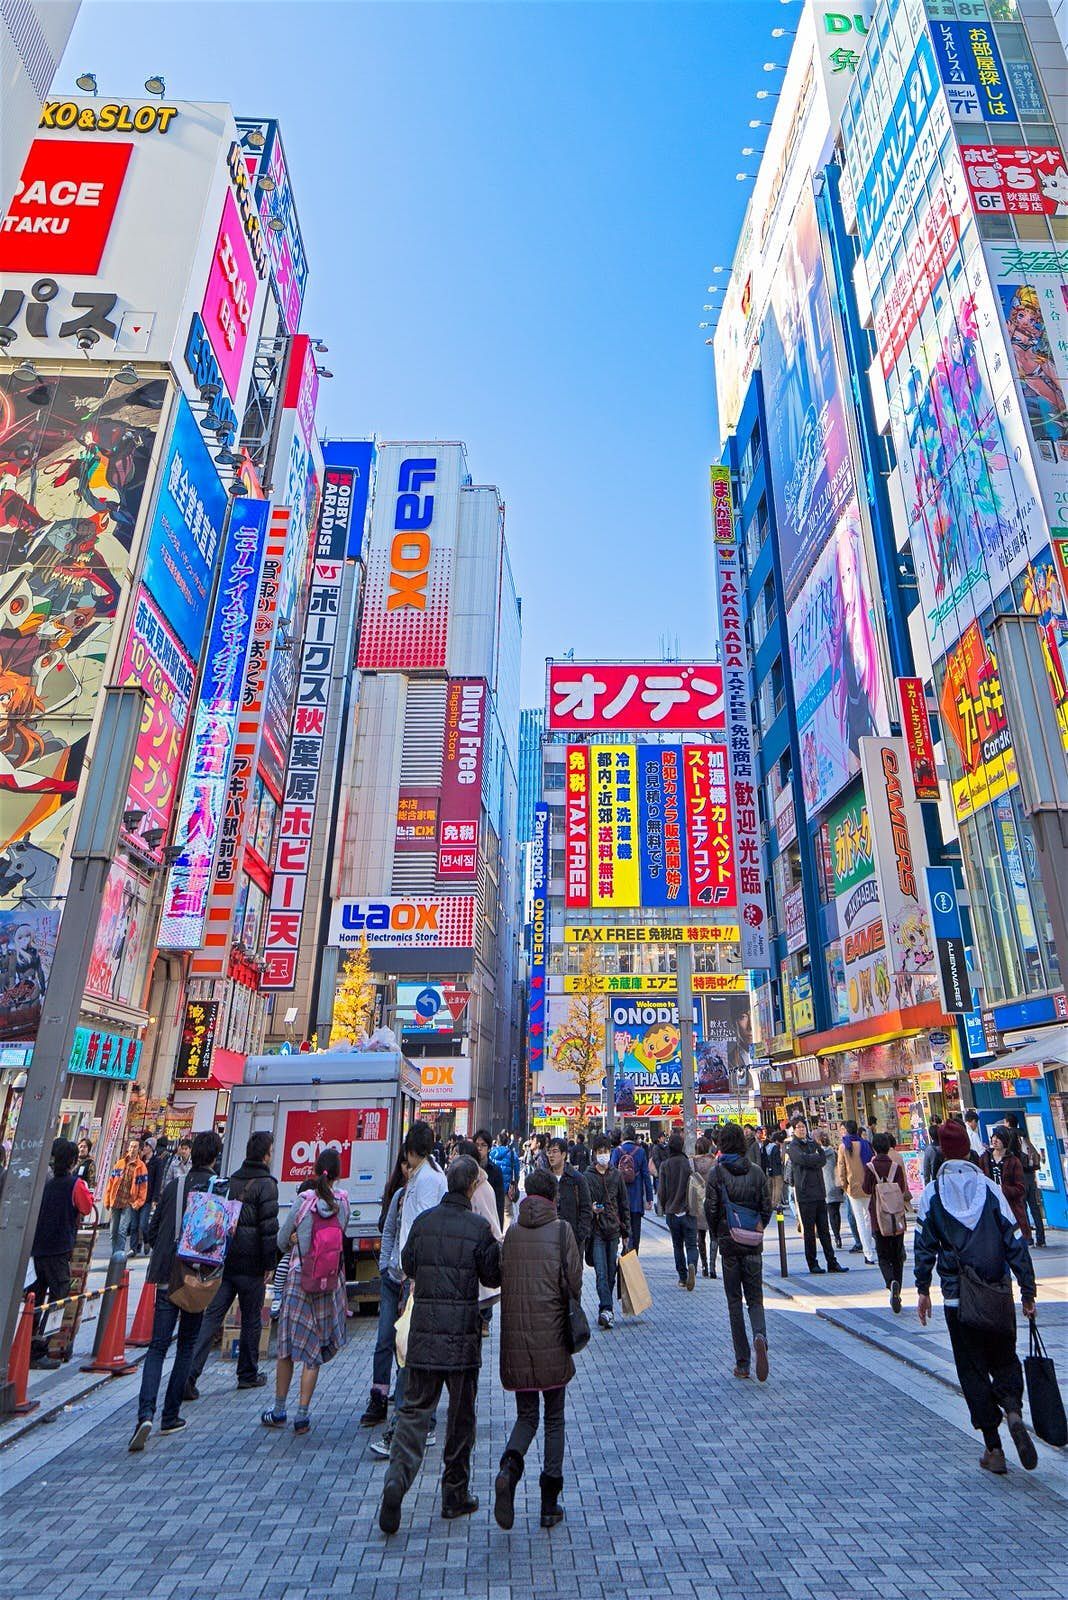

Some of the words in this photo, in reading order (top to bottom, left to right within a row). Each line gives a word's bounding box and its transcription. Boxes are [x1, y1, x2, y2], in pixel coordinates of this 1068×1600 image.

[959, 4, 985, 16] 8F
[969, 29, 1008, 114] お部屋探しは
[950, 100, 977, 114] 7F
[861, 51, 934, 242] レオパレス21
[964, 149, 1060, 164] ホビーランド
[967, 165, 1036, 189] ぽち
[1006, 192, 1041, 202] 秋葉原
[978, 195, 1001, 206] 6F
[1009, 202, 1044, 212] 2号店
[317, 472, 340, 556] PARADISE
[335, 472, 353, 529] HOBBY
[713, 478, 734, 539] まんが喫茶
[720, 571, 743, 667] TAKARADA
[449, 685, 461, 729] Flagship
[460, 685, 483, 733] Duty
[552, 667, 725, 722] オノデン
[447, 731, 458, 761] Store
[458, 737, 481, 784] Free
[731, 725, 751, 777] 免税商店
[568, 752, 586, 793] 免税
[216, 757, 247, 881] アキバ駅前店
[399, 799, 418, 809] 本店
[569, 796, 586, 836] TAX
[645, 761, 662, 878] お見積り無料です
[881, 747, 918, 903] GAMERS
[444, 825, 474, 840] 免税
[534, 811, 548, 889] Panasonic
[734, 781, 761, 894] 歓迎光臨
[569, 841, 587, 898] FREE
[697, 886, 728, 903] 4F
[366, 932, 413, 942] Electronics
[415, 932, 439, 942] Store
[531, 898, 546, 966] ONODEN
[573, 928, 603, 942] TAX
[606, 928, 646, 941] FREE
[648, 927, 684, 941] 免税店
[607, 977, 643, 990] 冷蔵庫
[646, 978, 678, 989] エアコ
[365, 1112, 380, 1123] 100
